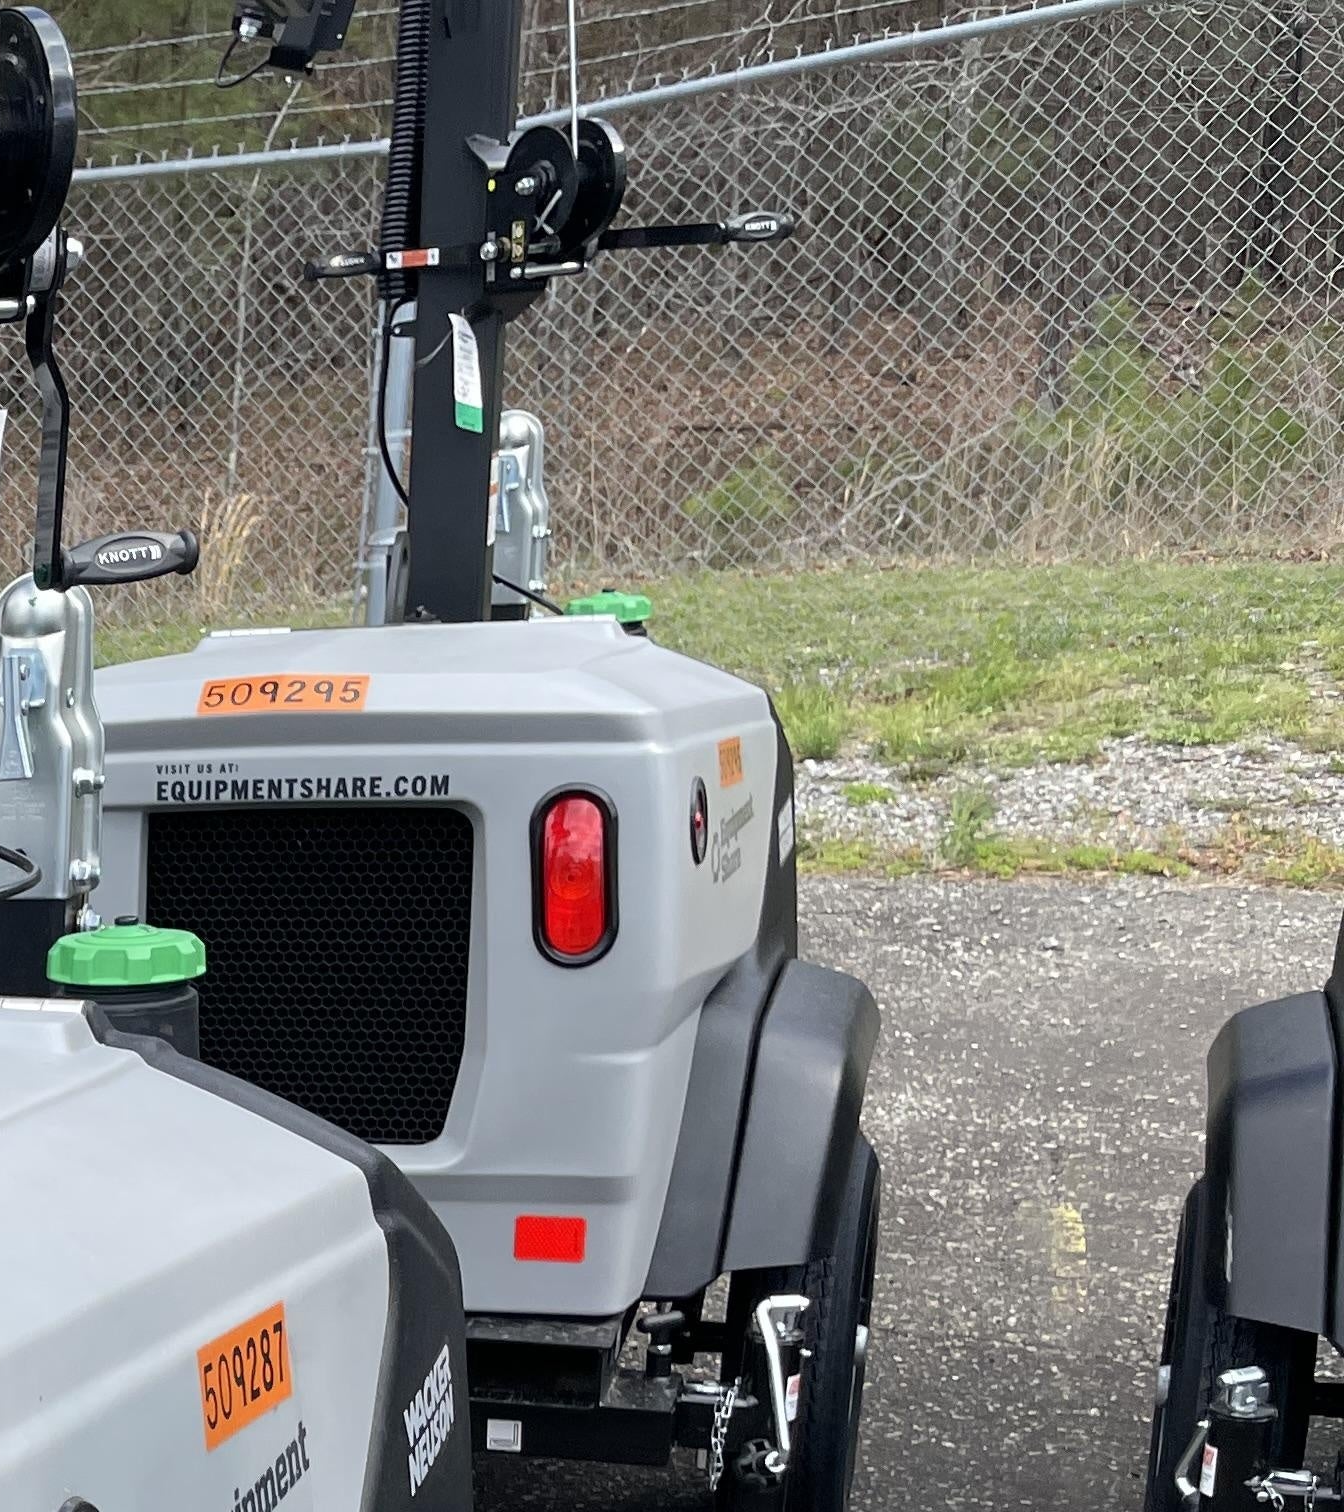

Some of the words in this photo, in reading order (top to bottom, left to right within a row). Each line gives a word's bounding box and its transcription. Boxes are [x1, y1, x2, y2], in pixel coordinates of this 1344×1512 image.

[98, 546, 148, 565] KNOTT
[203, 679, 361, 708] 509295
[156, 764, 191, 775] VISIT
[197, 763, 213, 774] US
[219, 763, 239, 774] AT:
[156, 774, 450, 802] EQUIPMENTSHARE.COM
[203, 1319, 286, 1430] 509287
[403, 1343, 452, 1448] WACKER
[408, 1382, 455, 1497] NEUSON
